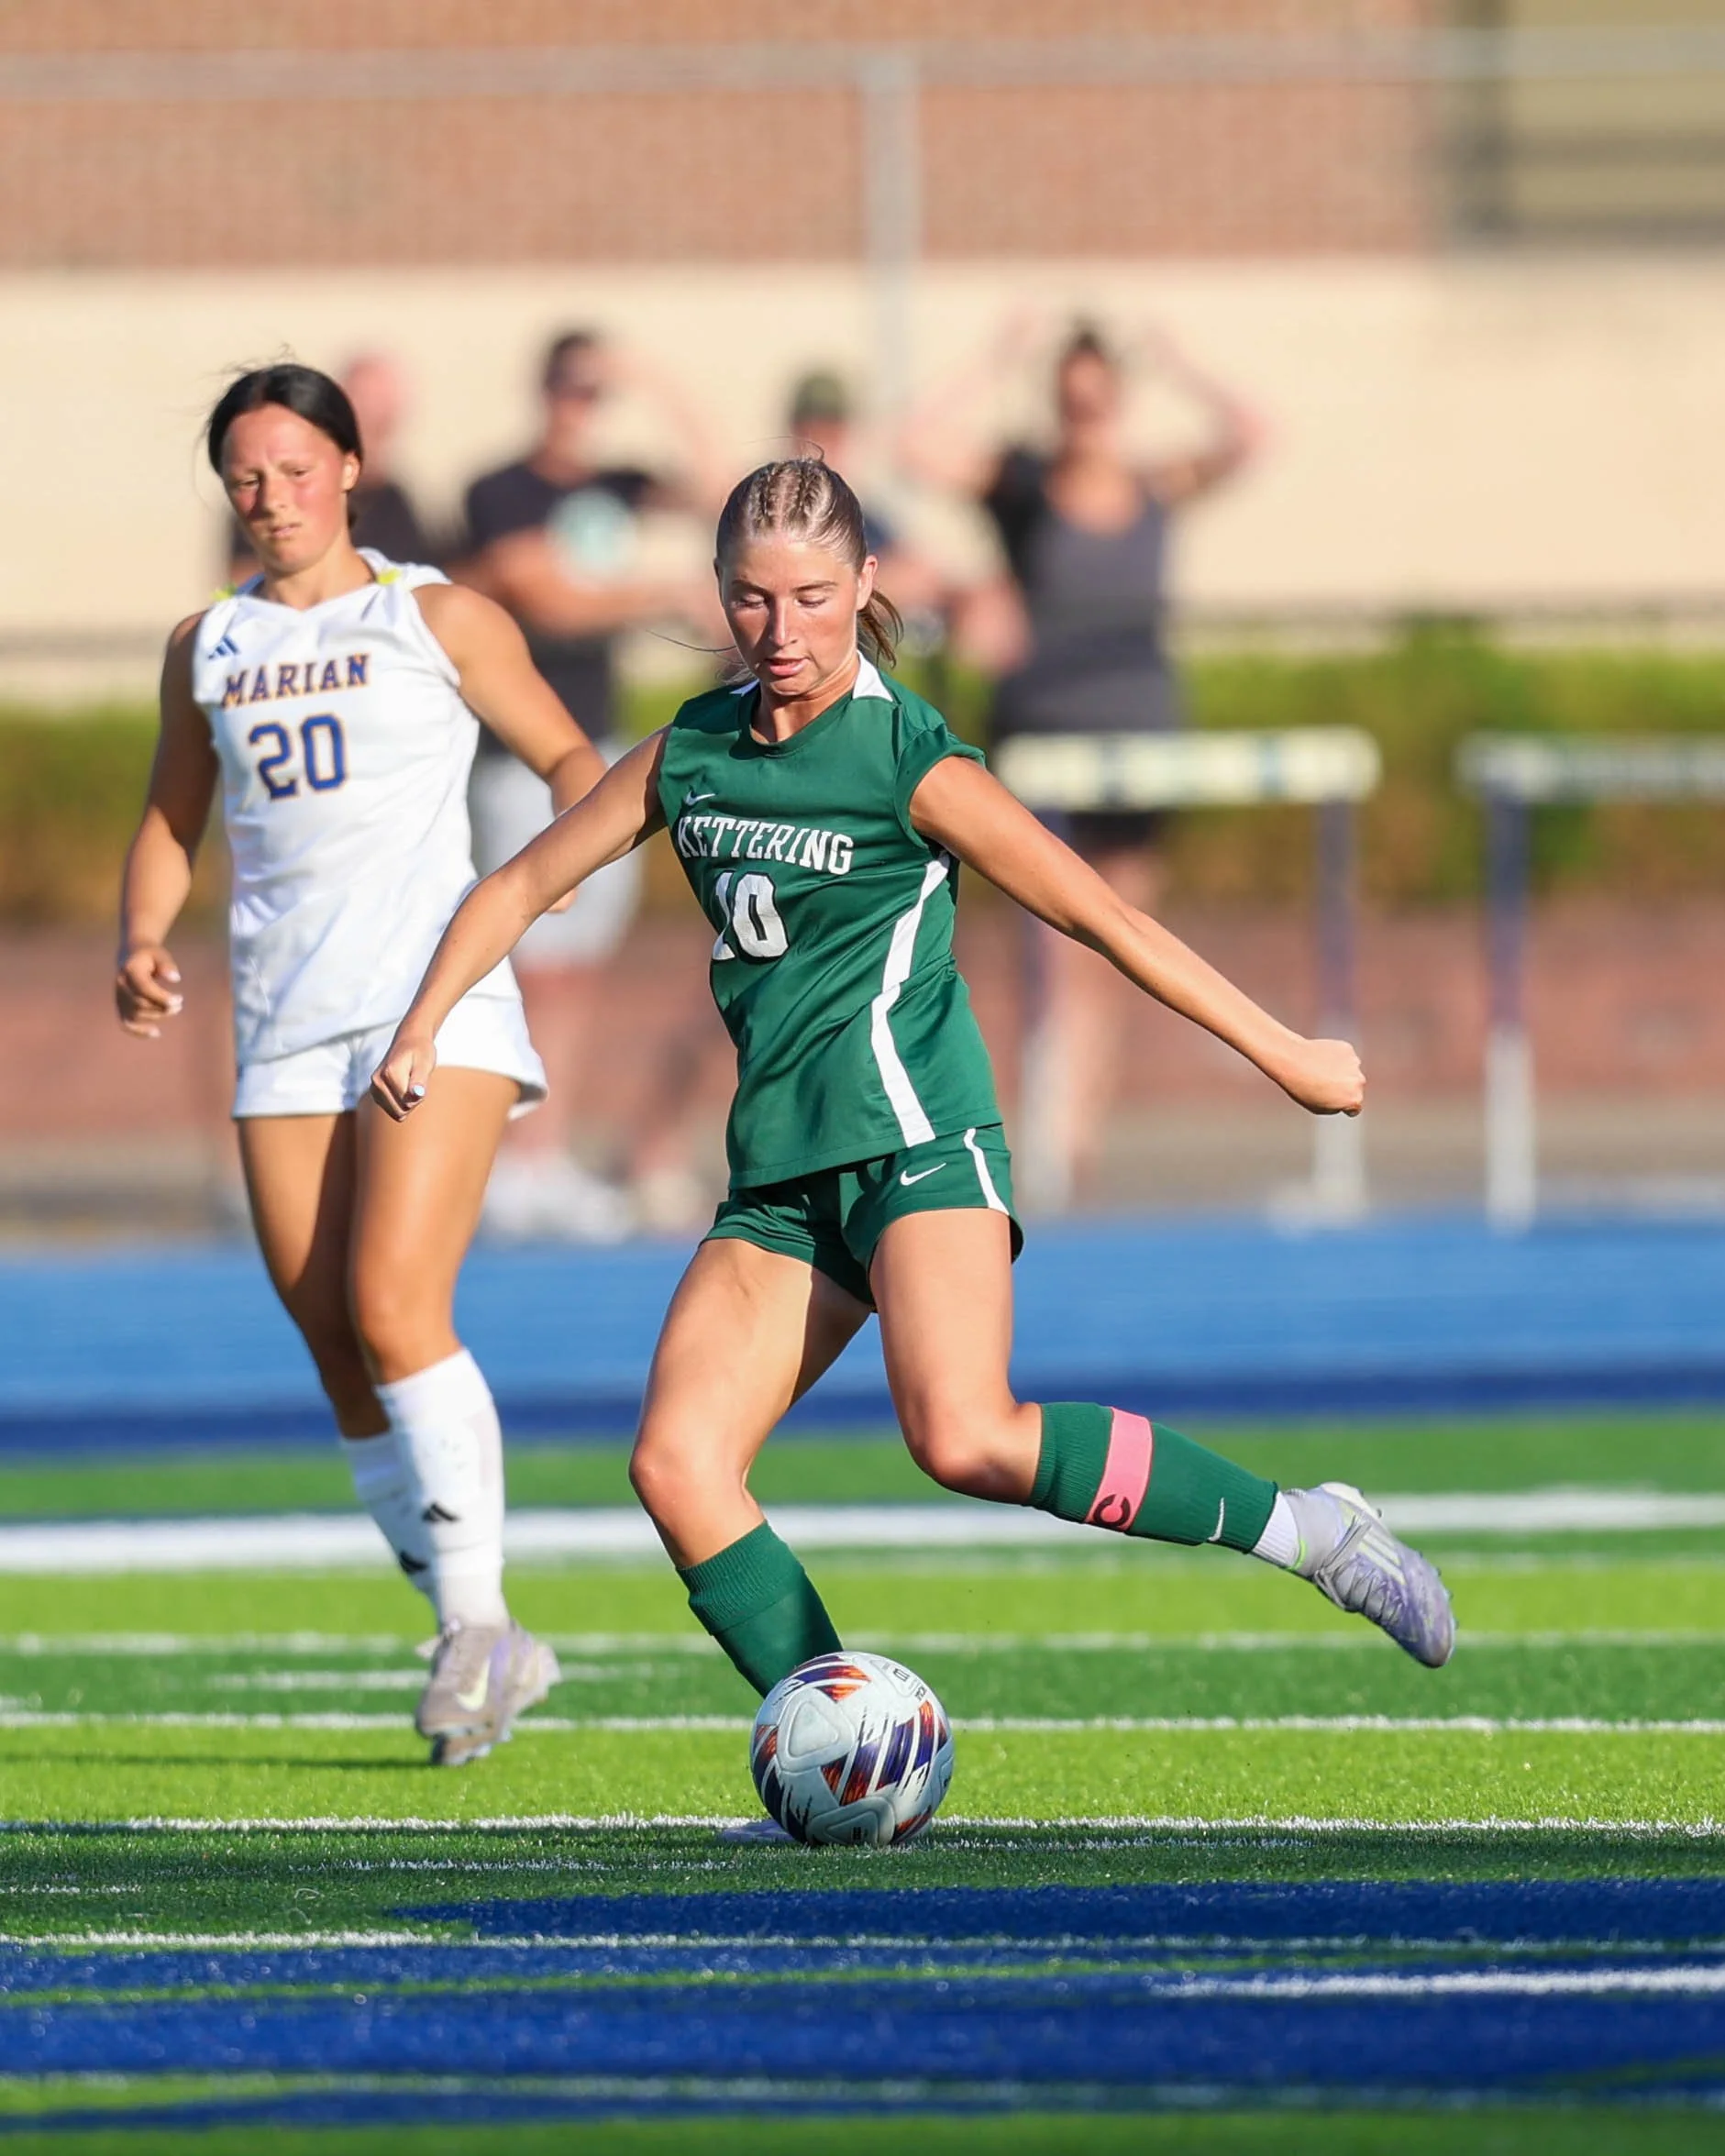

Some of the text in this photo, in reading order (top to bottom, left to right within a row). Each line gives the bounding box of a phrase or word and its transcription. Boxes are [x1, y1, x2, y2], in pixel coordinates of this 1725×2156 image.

[221, 652, 370, 711] MARIAN
[247, 713, 348, 802] 20
[677, 814, 856, 876] KETTERING
